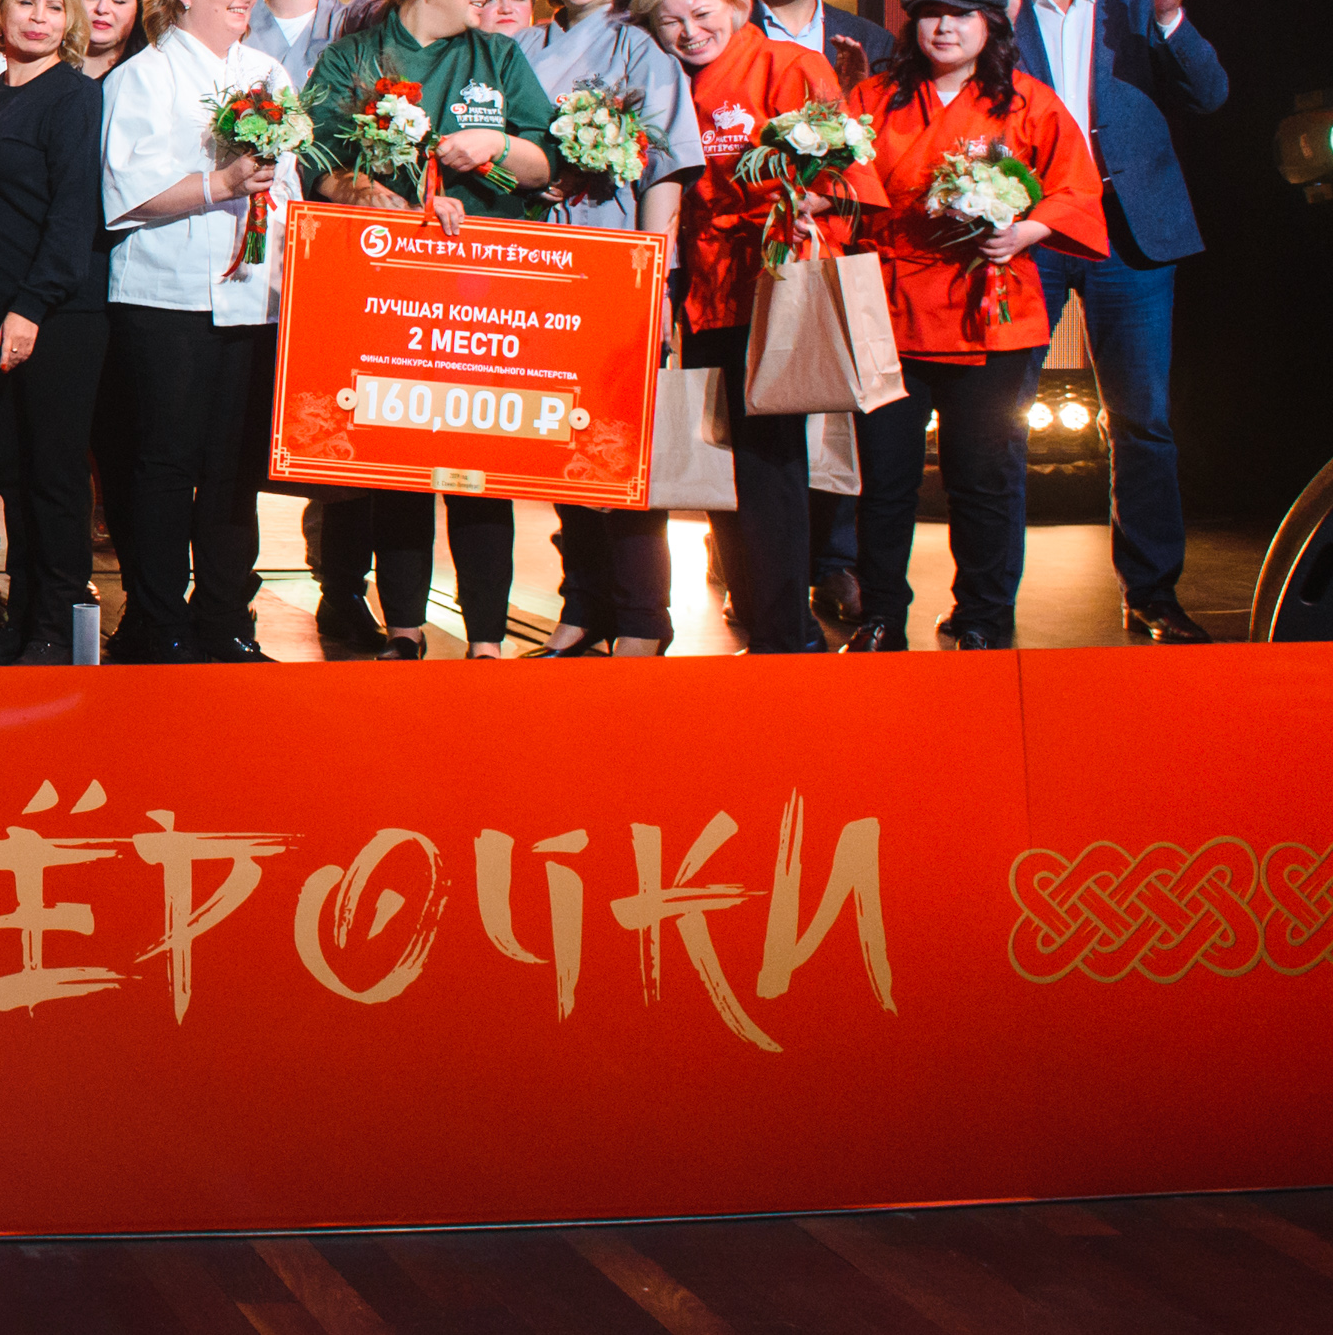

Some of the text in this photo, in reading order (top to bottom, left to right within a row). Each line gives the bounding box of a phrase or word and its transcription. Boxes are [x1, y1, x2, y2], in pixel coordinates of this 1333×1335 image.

[395, 237, 465, 257] МАСТЕРА
[472, 243, 573, 269] ПЯТЁРОЧКИ
[365, 297, 582, 331] ЛУЧШАЯ КОМАНДА 2019
[408, 327, 520, 358] 2 МЕСТО
[360, 354, 578, 380] ФИНАЛ КОНКУРСА ПРОФЕССИОНАЛЬНОГО МАСТЕРСТВА
